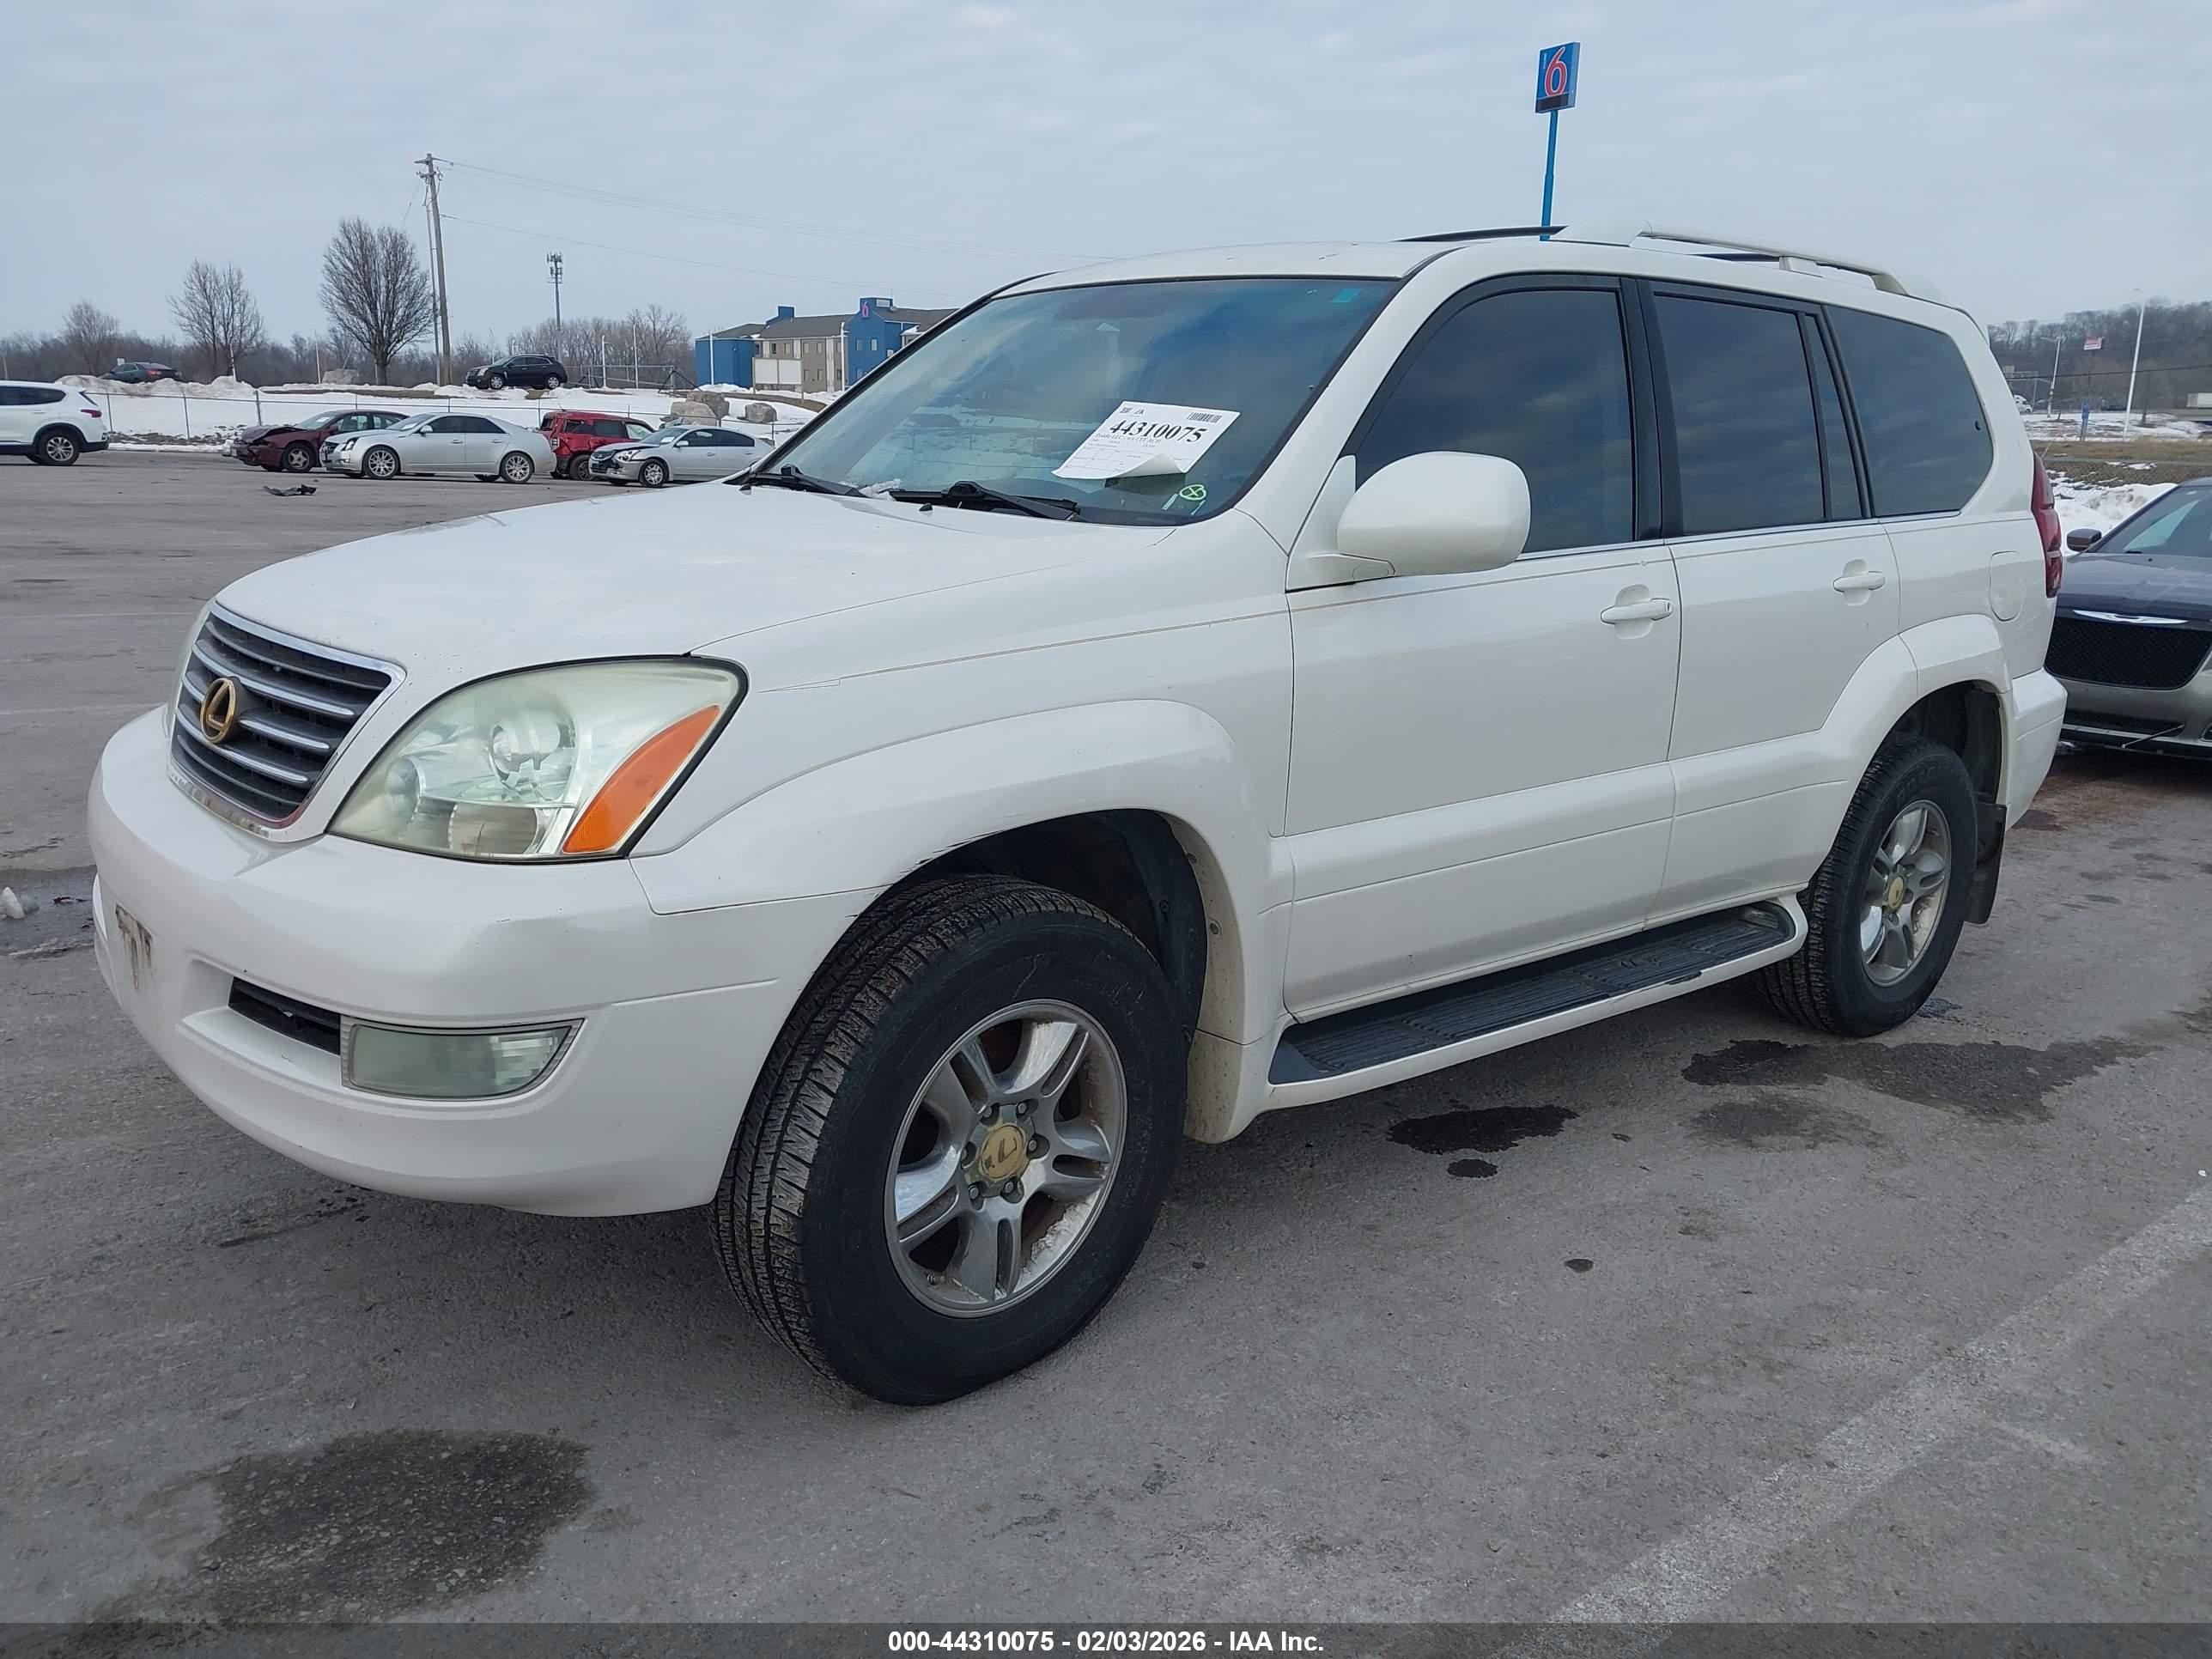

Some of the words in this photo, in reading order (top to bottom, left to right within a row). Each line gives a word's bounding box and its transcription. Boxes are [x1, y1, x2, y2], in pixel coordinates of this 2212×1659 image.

[1544, 46, 1568, 97] 6
[862, 300, 869, 318] 6
[1109, 420, 1209, 442] 44310075
